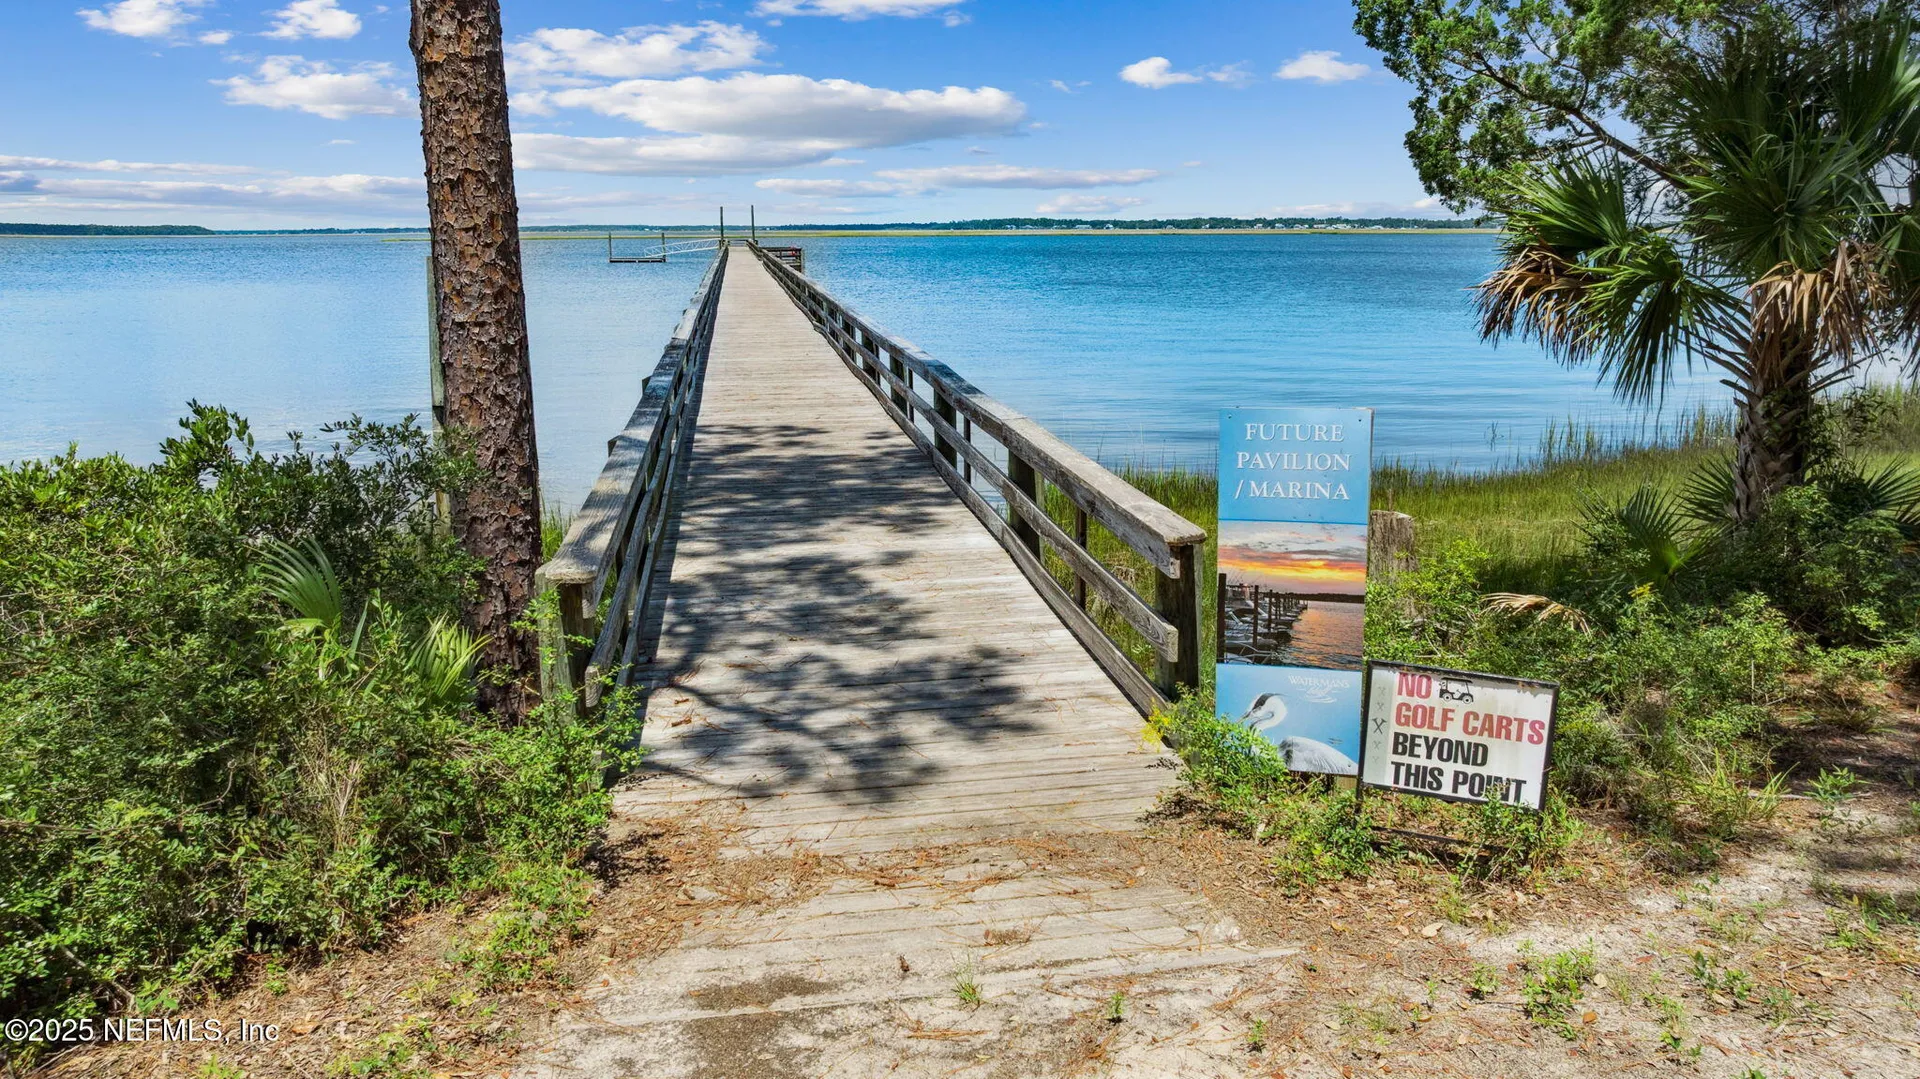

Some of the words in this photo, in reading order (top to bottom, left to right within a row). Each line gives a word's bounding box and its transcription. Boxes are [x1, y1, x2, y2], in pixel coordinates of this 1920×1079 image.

[1245, 423, 1344, 442] FUTURE
[1236, 451, 1351, 471] PAVILION
[1288, 674, 1350, 688] WATERMANS
[1397, 672, 1432, 699] NO
[1395, 702, 1455, 732] GOLF
[1462, 711, 1546, 745] CARTS
[1392, 731, 1489, 767] BEYOND
[1391, 761, 1444, 791] THIS
